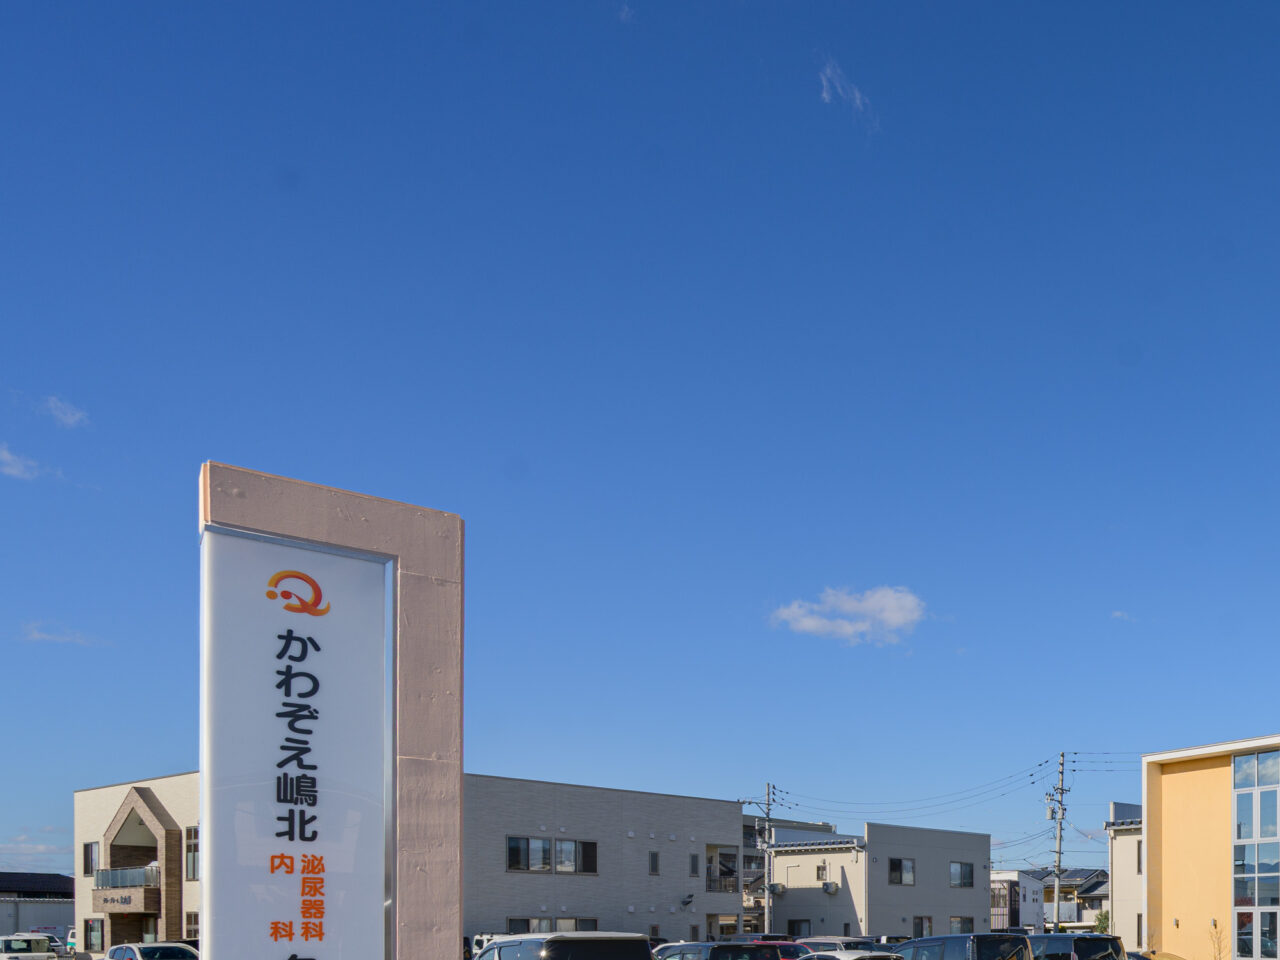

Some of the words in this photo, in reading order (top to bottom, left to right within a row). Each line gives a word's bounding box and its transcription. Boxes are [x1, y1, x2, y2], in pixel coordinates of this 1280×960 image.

[275, 629, 321, 842] かわぞえ嶋北
[300, 853, 326, 942] 泌尿器科
